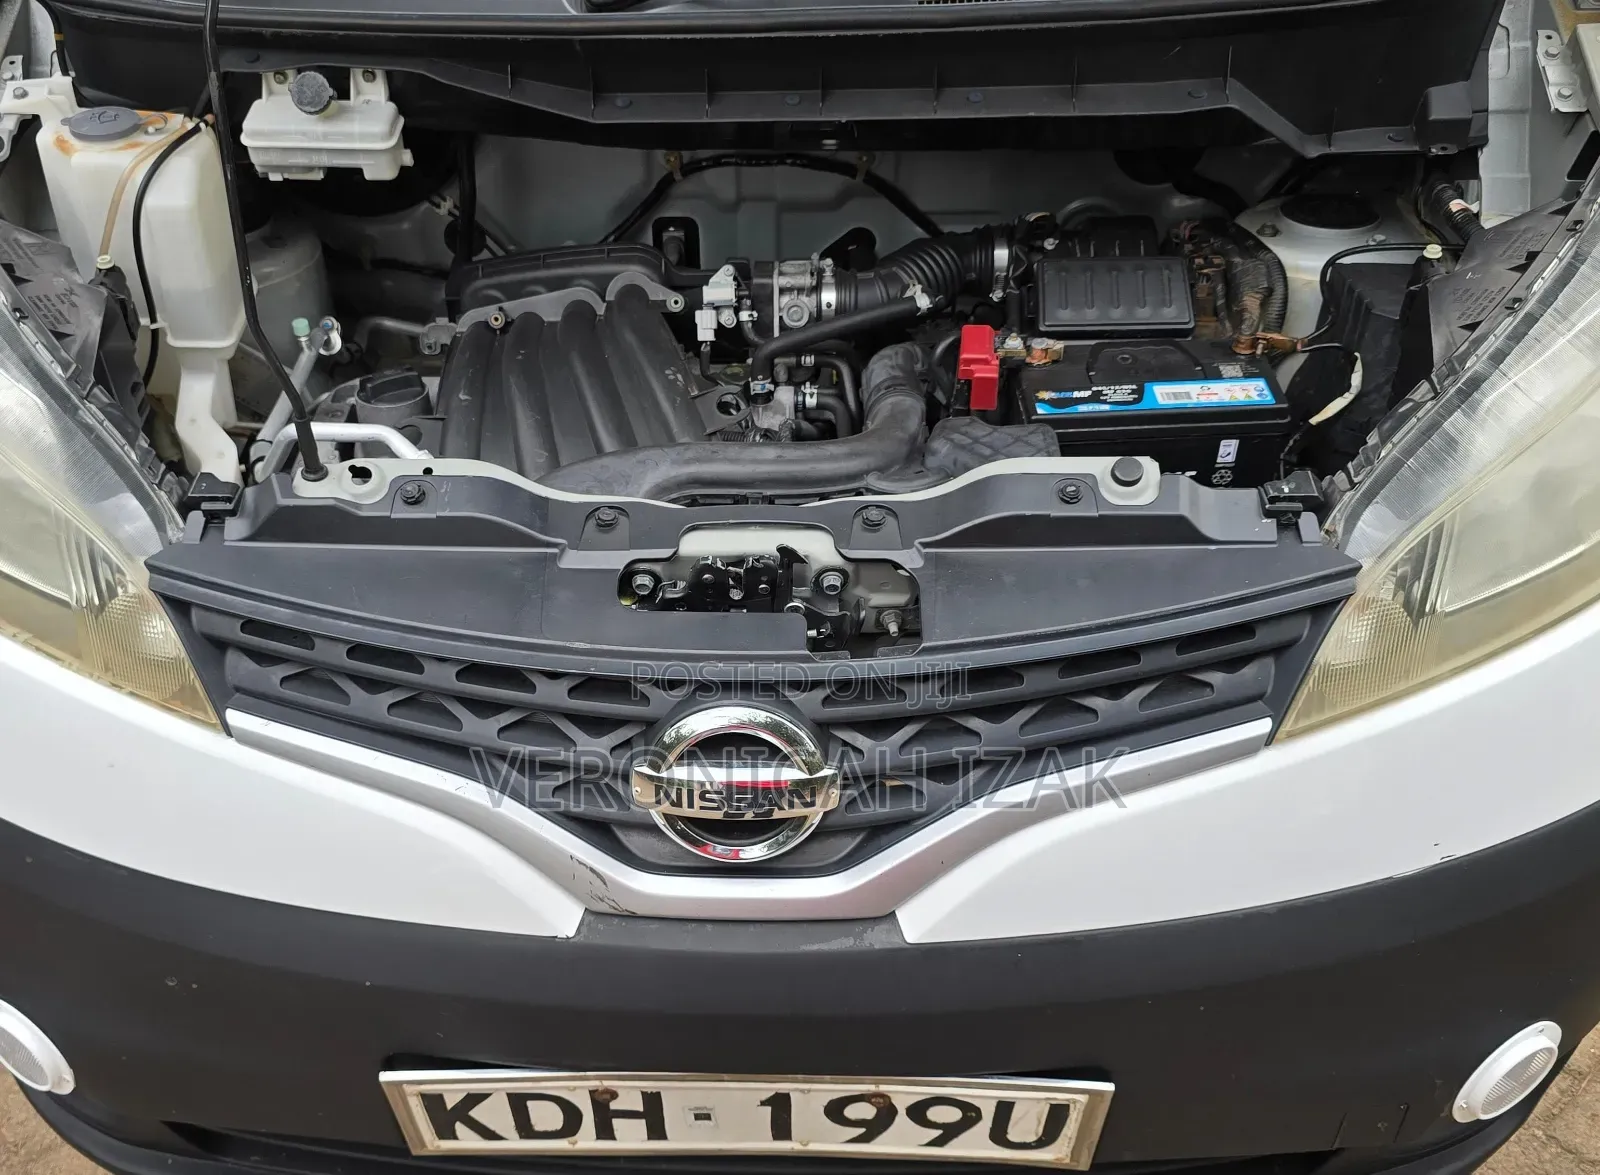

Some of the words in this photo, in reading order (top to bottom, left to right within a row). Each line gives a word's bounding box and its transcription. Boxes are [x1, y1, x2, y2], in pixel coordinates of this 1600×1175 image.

[654, 784, 817, 812] NISSAN
[424, 1091, 668, 1142] KDH
[757, 1091, 1070, 1149] 199U
